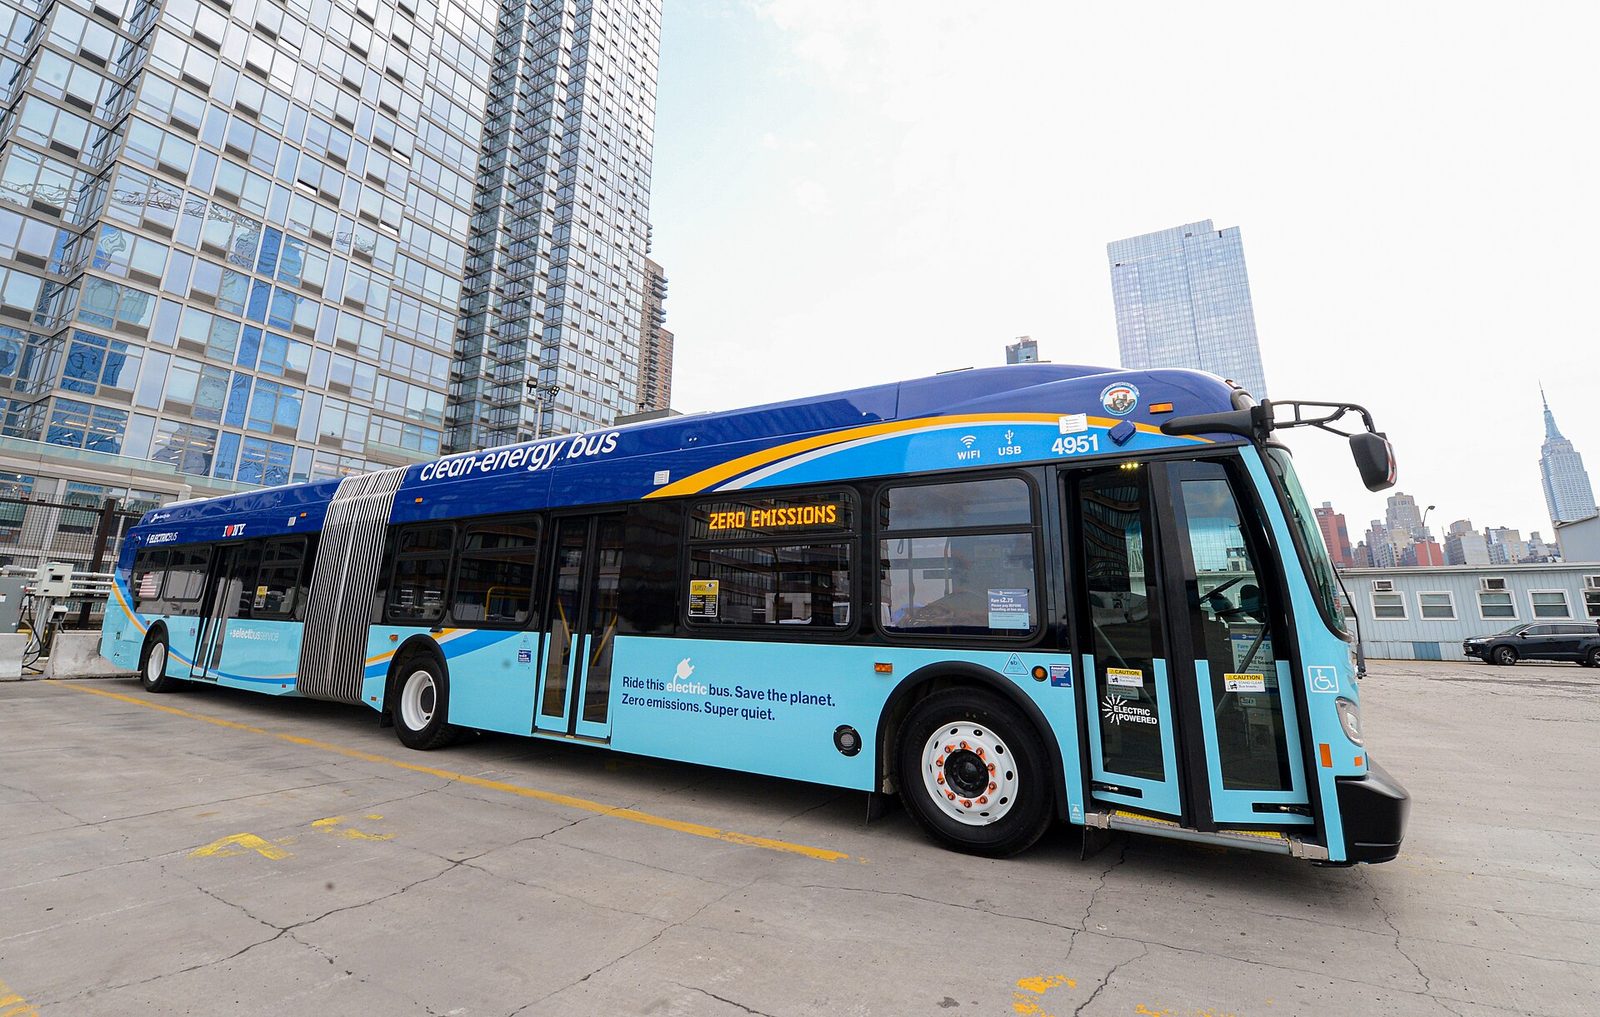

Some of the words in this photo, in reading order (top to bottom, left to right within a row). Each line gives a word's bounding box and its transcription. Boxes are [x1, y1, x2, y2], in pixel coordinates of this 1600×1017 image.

[998, 445, 1022, 456] USB
[1051, 433, 1099, 455] 4951
[420, 440, 567, 481] clean-energy
[566, 431, 620, 459] bus
[957, 449, 981, 460] WIFI
[709, 511, 746, 530] ZERO
[751, 505, 837, 528] EMISSIONS
[231, 523, 246, 537] NY
[622, 676, 645, 689] Ride
[646, 678, 665, 691] this
[666, 680, 708, 695] electric
[709, 683, 733, 698] bus.
[735, 685, 765, 700] Save
[767, 688, 788, 702] the
[790, 691, 836, 707] planet.
[621, 693, 645, 707] Zero
[646, 698, 702, 713] emissions.
[704, 701, 739, 718] Super
[741, 706, 776, 721] quiet.
[1113, 705, 1151, 716] ELECTRIC
[1119, 713, 1158, 725] POWERED
